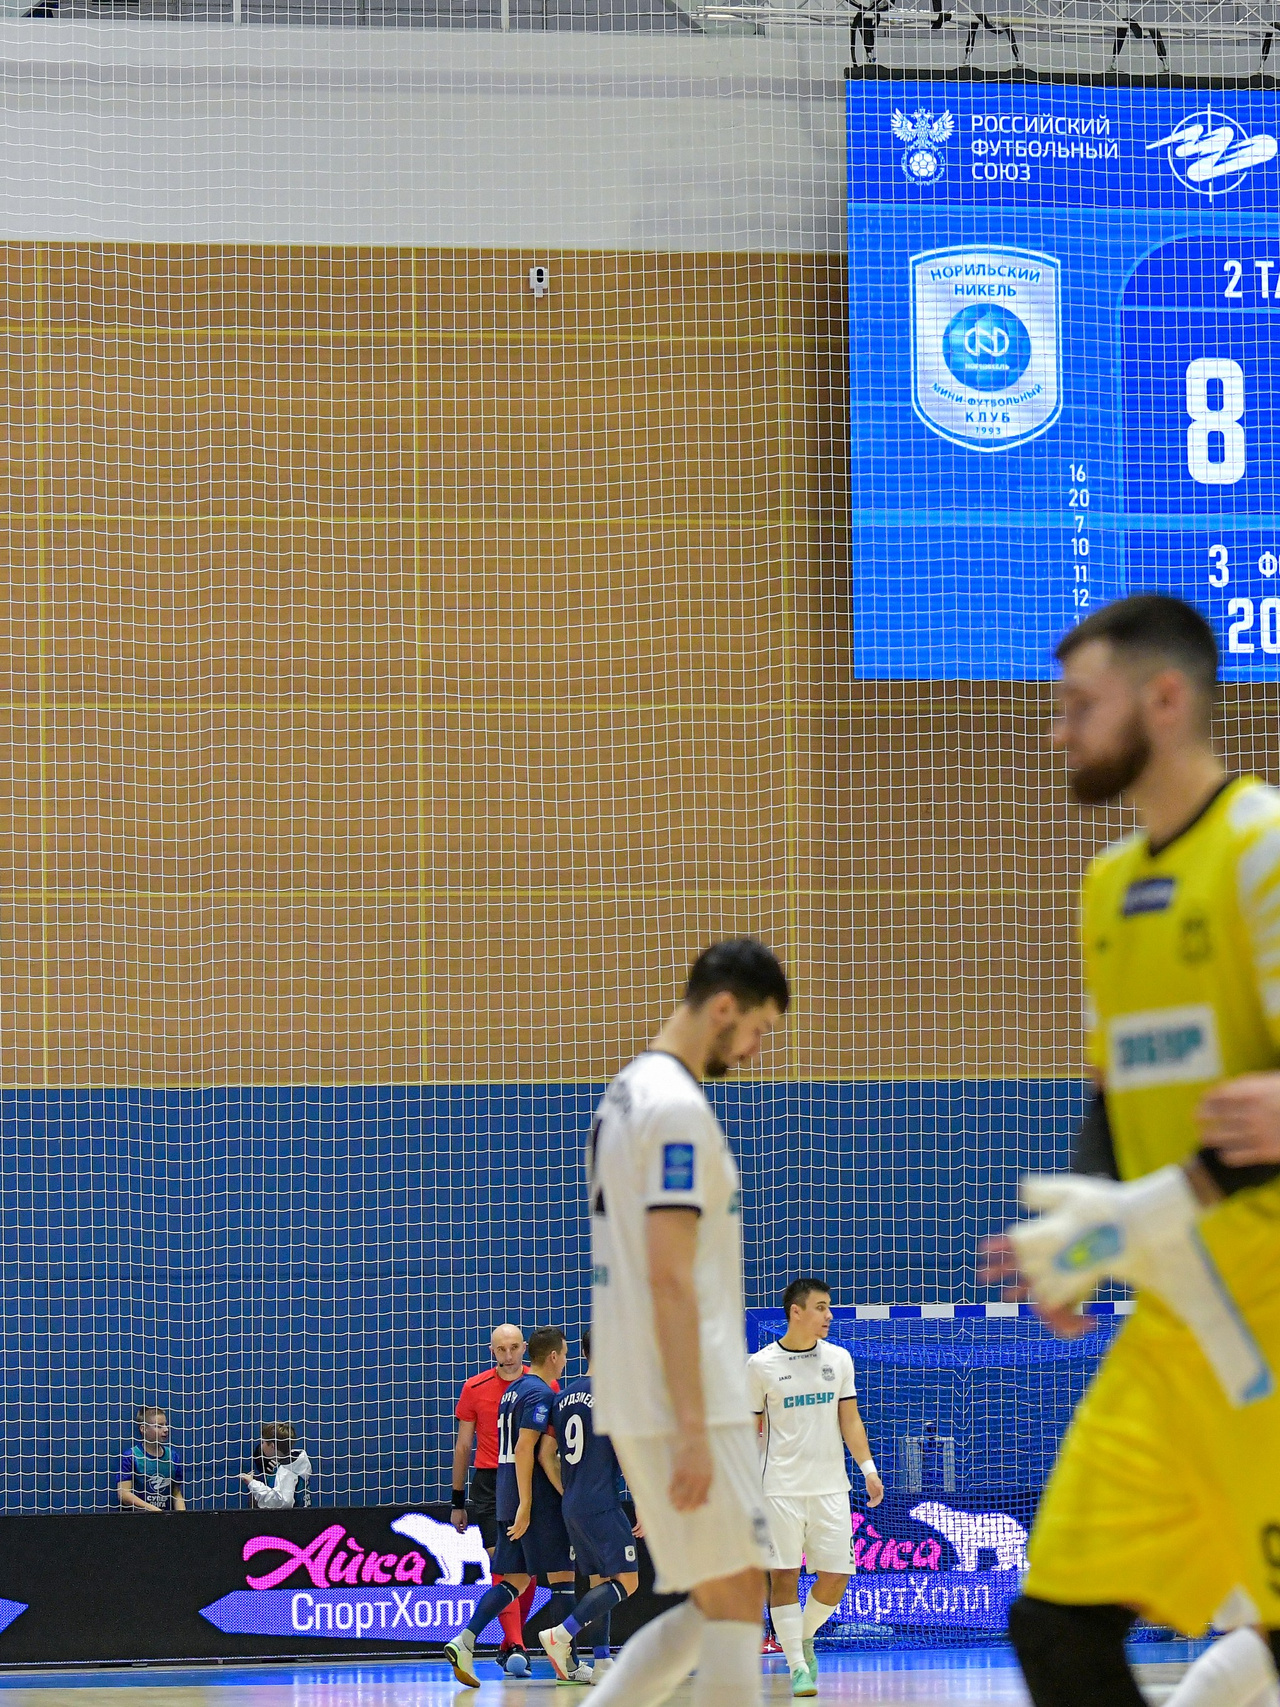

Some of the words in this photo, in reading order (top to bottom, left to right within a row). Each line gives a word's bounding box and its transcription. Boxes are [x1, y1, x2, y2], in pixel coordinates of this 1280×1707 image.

[971, 114, 1111, 136] РОССИЙСКИЙ
[971, 138, 1119, 160] ФУТБОЛЬНЫЙ
[971, 161, 1031, 182] СОЮЗ
[930, 263, 1041, 284] НОРИЛЬСКИЙ
[1223, 260, 1244, 299] 2
[954, 284, 1017, 297] НИКЕЛЬ
[965, 412, 1011, 424] КЛУБ
[1185, 357, 1246, 485] 8
[975, 427, 1001, 435] 1993
[1068, 464, 1087, 482] 16
[1068, 489, 1090, 507] 20
[1074, 515, 1084, 533] 7
[1071, 538, 1089, 556] 10
[1073, 565, 1087, 583] 11
[1208, 544, 1230, 588] 3
[1072, 588, 1089, 607] 12
[783, 1391, 836, 1409] СИБУР
[497, 1412, 516, 1464] 11
[565, 1413, 584, 1465] 9
[243, 1524, 427, 1590] Айка
[291, 1590, 475, 1639] СпортХолл
